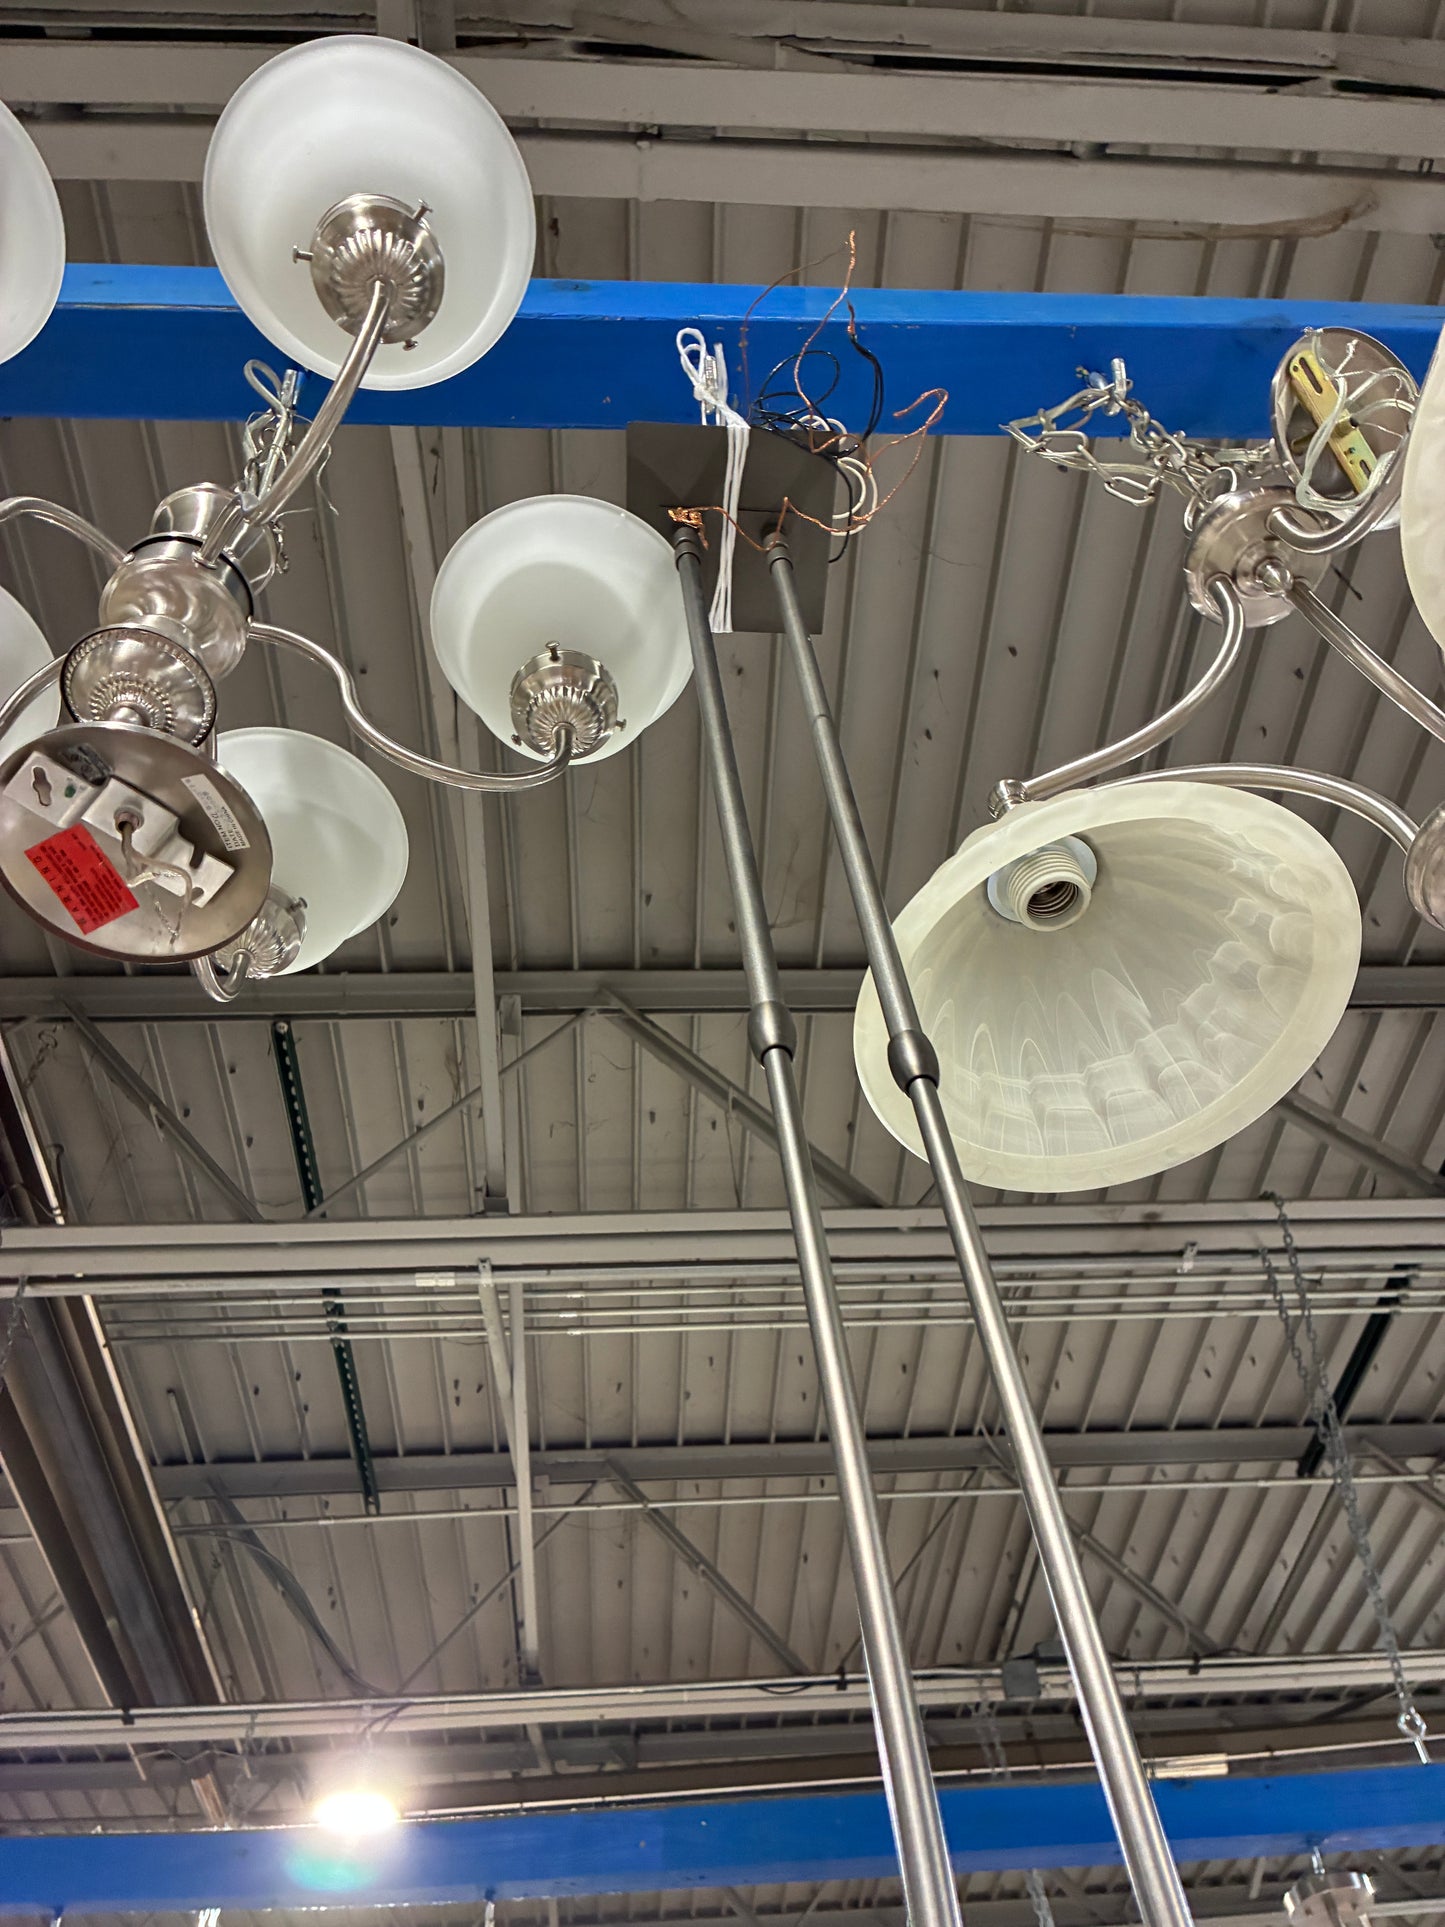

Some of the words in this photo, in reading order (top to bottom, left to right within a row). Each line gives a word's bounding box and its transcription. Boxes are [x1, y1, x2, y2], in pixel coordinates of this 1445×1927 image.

[220, 831, 232, 849] ITEM
[228, 830, 240, 847] DATE
[33, 856, 87, 925] WARNING
